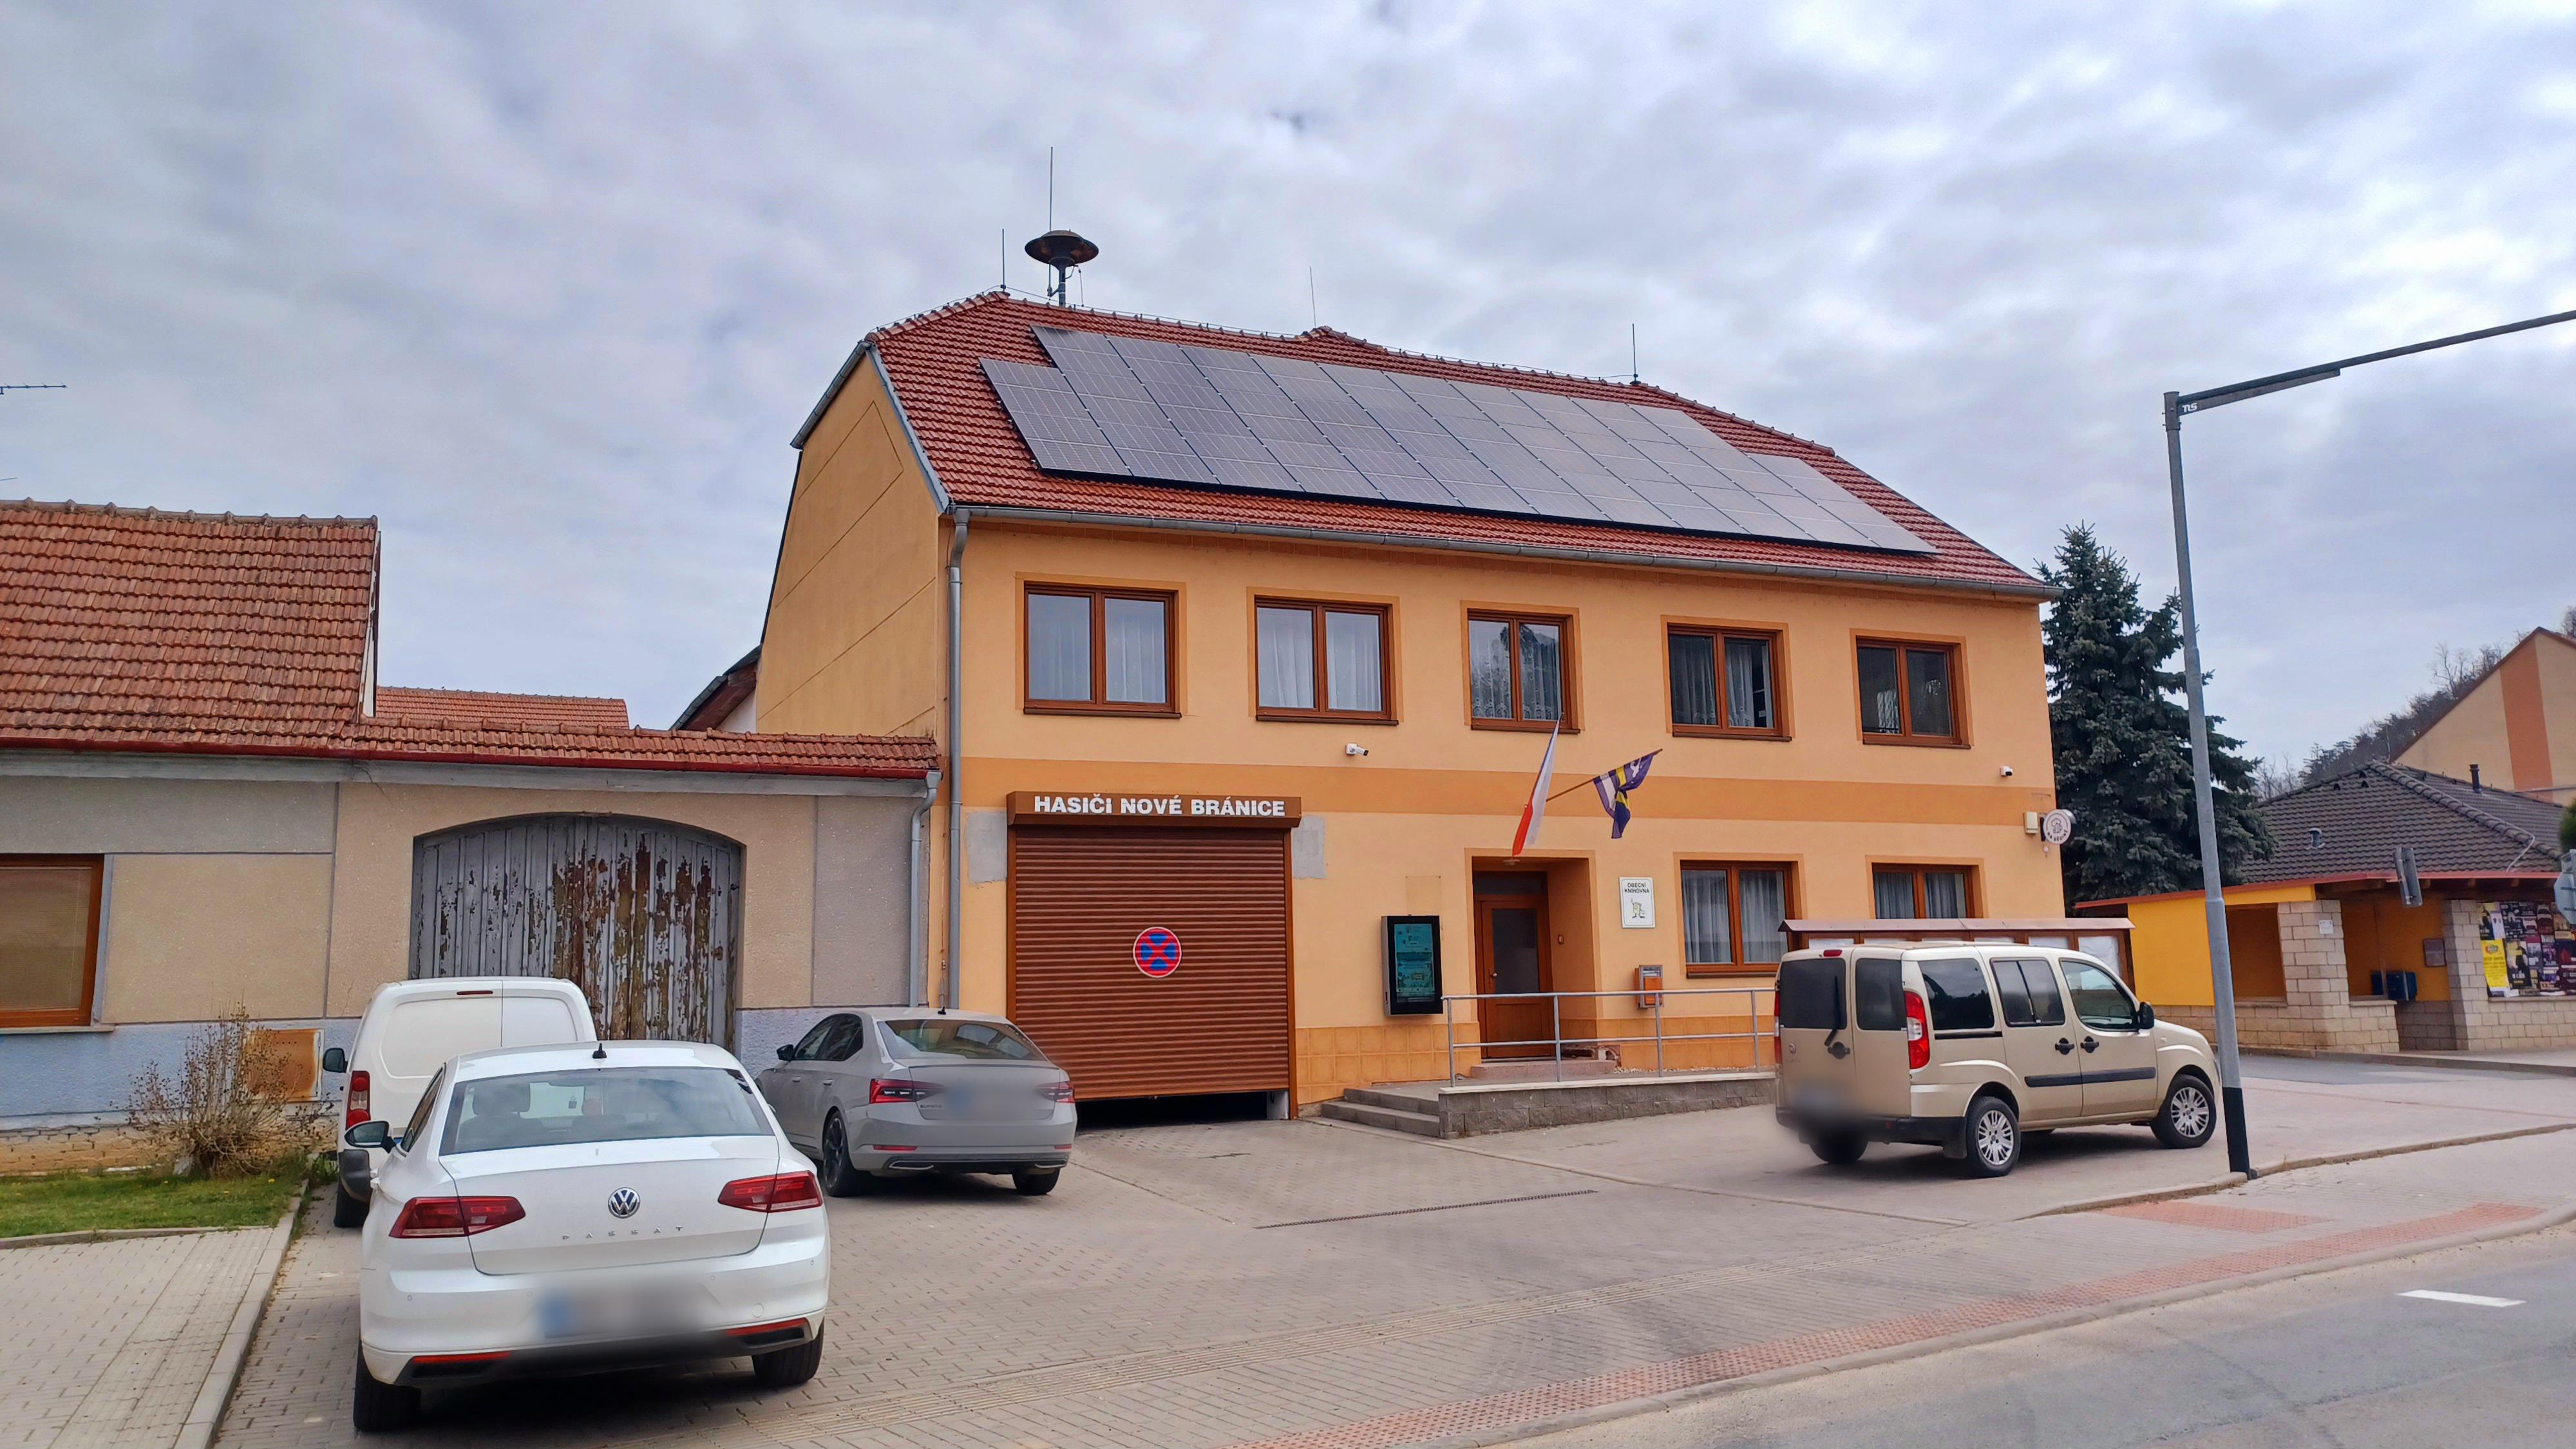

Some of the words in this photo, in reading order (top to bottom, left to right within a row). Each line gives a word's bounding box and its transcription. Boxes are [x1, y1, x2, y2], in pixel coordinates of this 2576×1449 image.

[1034, 793, 1112, 815] HASIČI
[1121, 794, 1182, 815] NOVÉ
[1191, 796, 1285, 817] BRÁNICE
[562, 1226, 683, 1240] PASSAT
